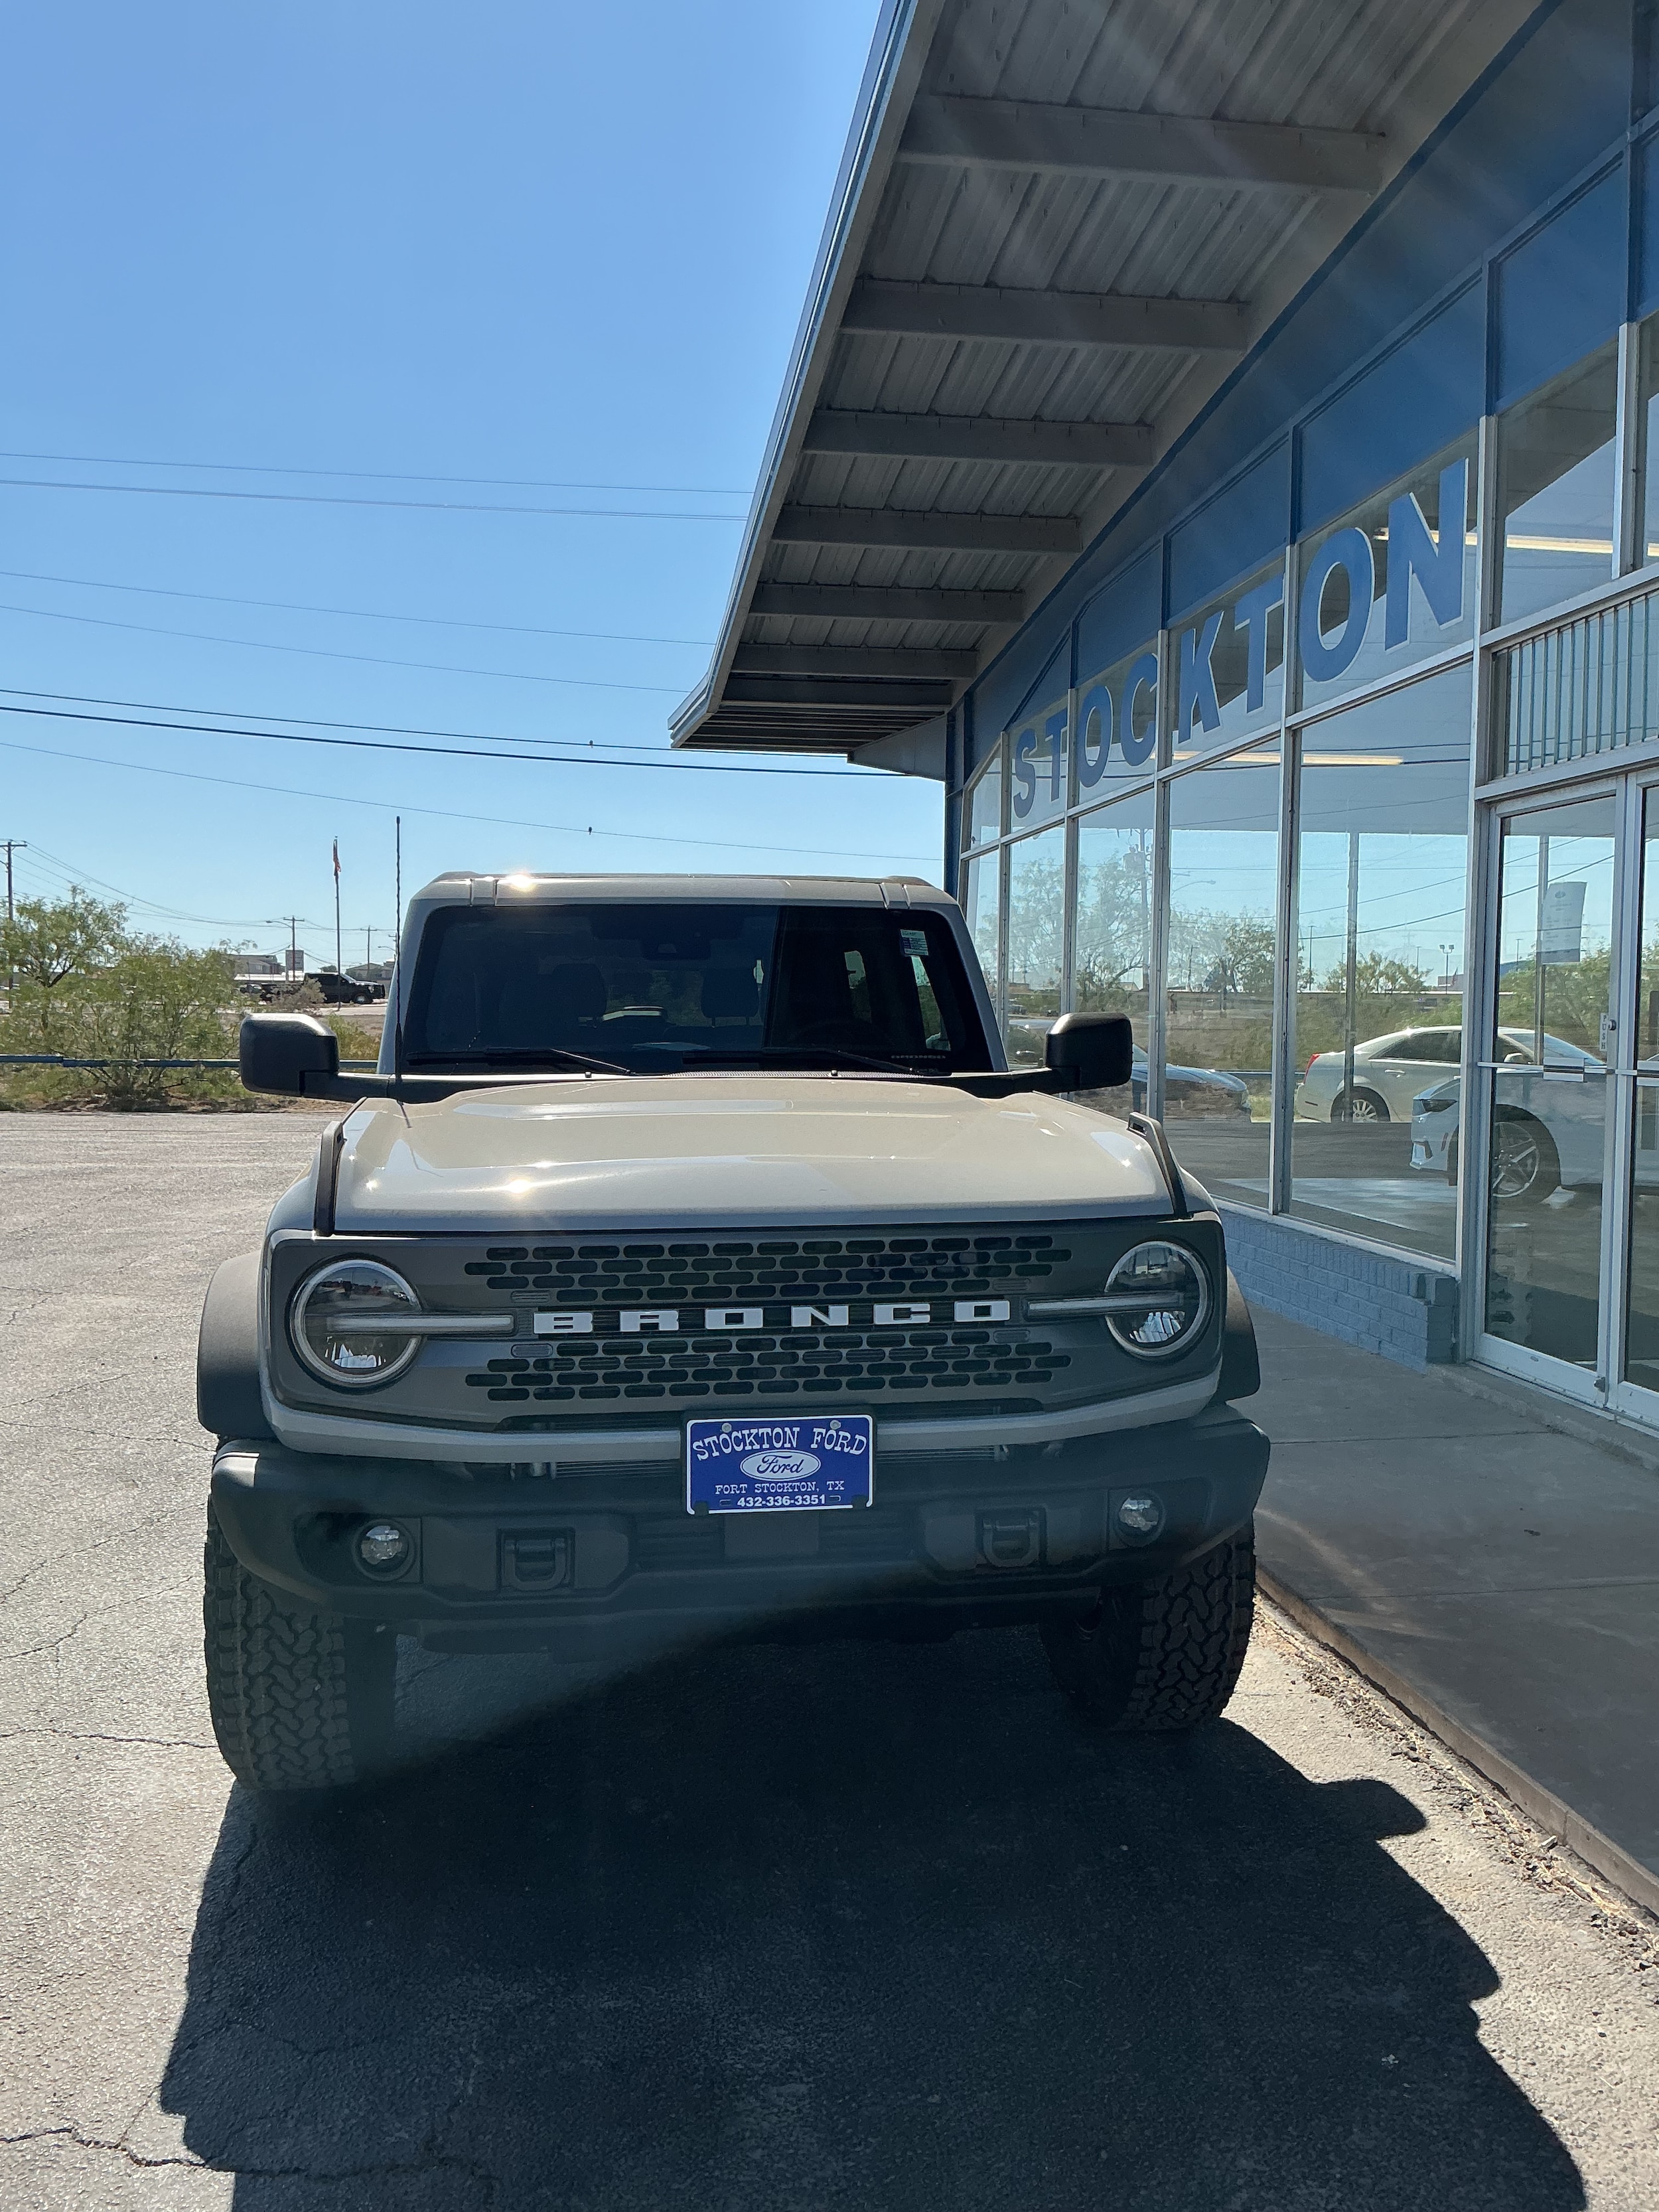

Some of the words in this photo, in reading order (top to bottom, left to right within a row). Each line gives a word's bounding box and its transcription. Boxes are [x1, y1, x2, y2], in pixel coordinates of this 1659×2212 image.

[1013, 457, 1469, 819] STOCKTON
[533, 1300, 1011, 1334] BRONCO
[692, 1427, 800, 1461] STOCKTON
[810, 1428, 867, 1455] FORD
[757, 1455, 804, 1475] Ford
[715, 1484, 748, 1495] FORT
[755, 1482, 820, 1493] STOCKTON,
[827, 1481, 845, 1491] TX
[737, 1495, 826, 1507] 432-336-3351
